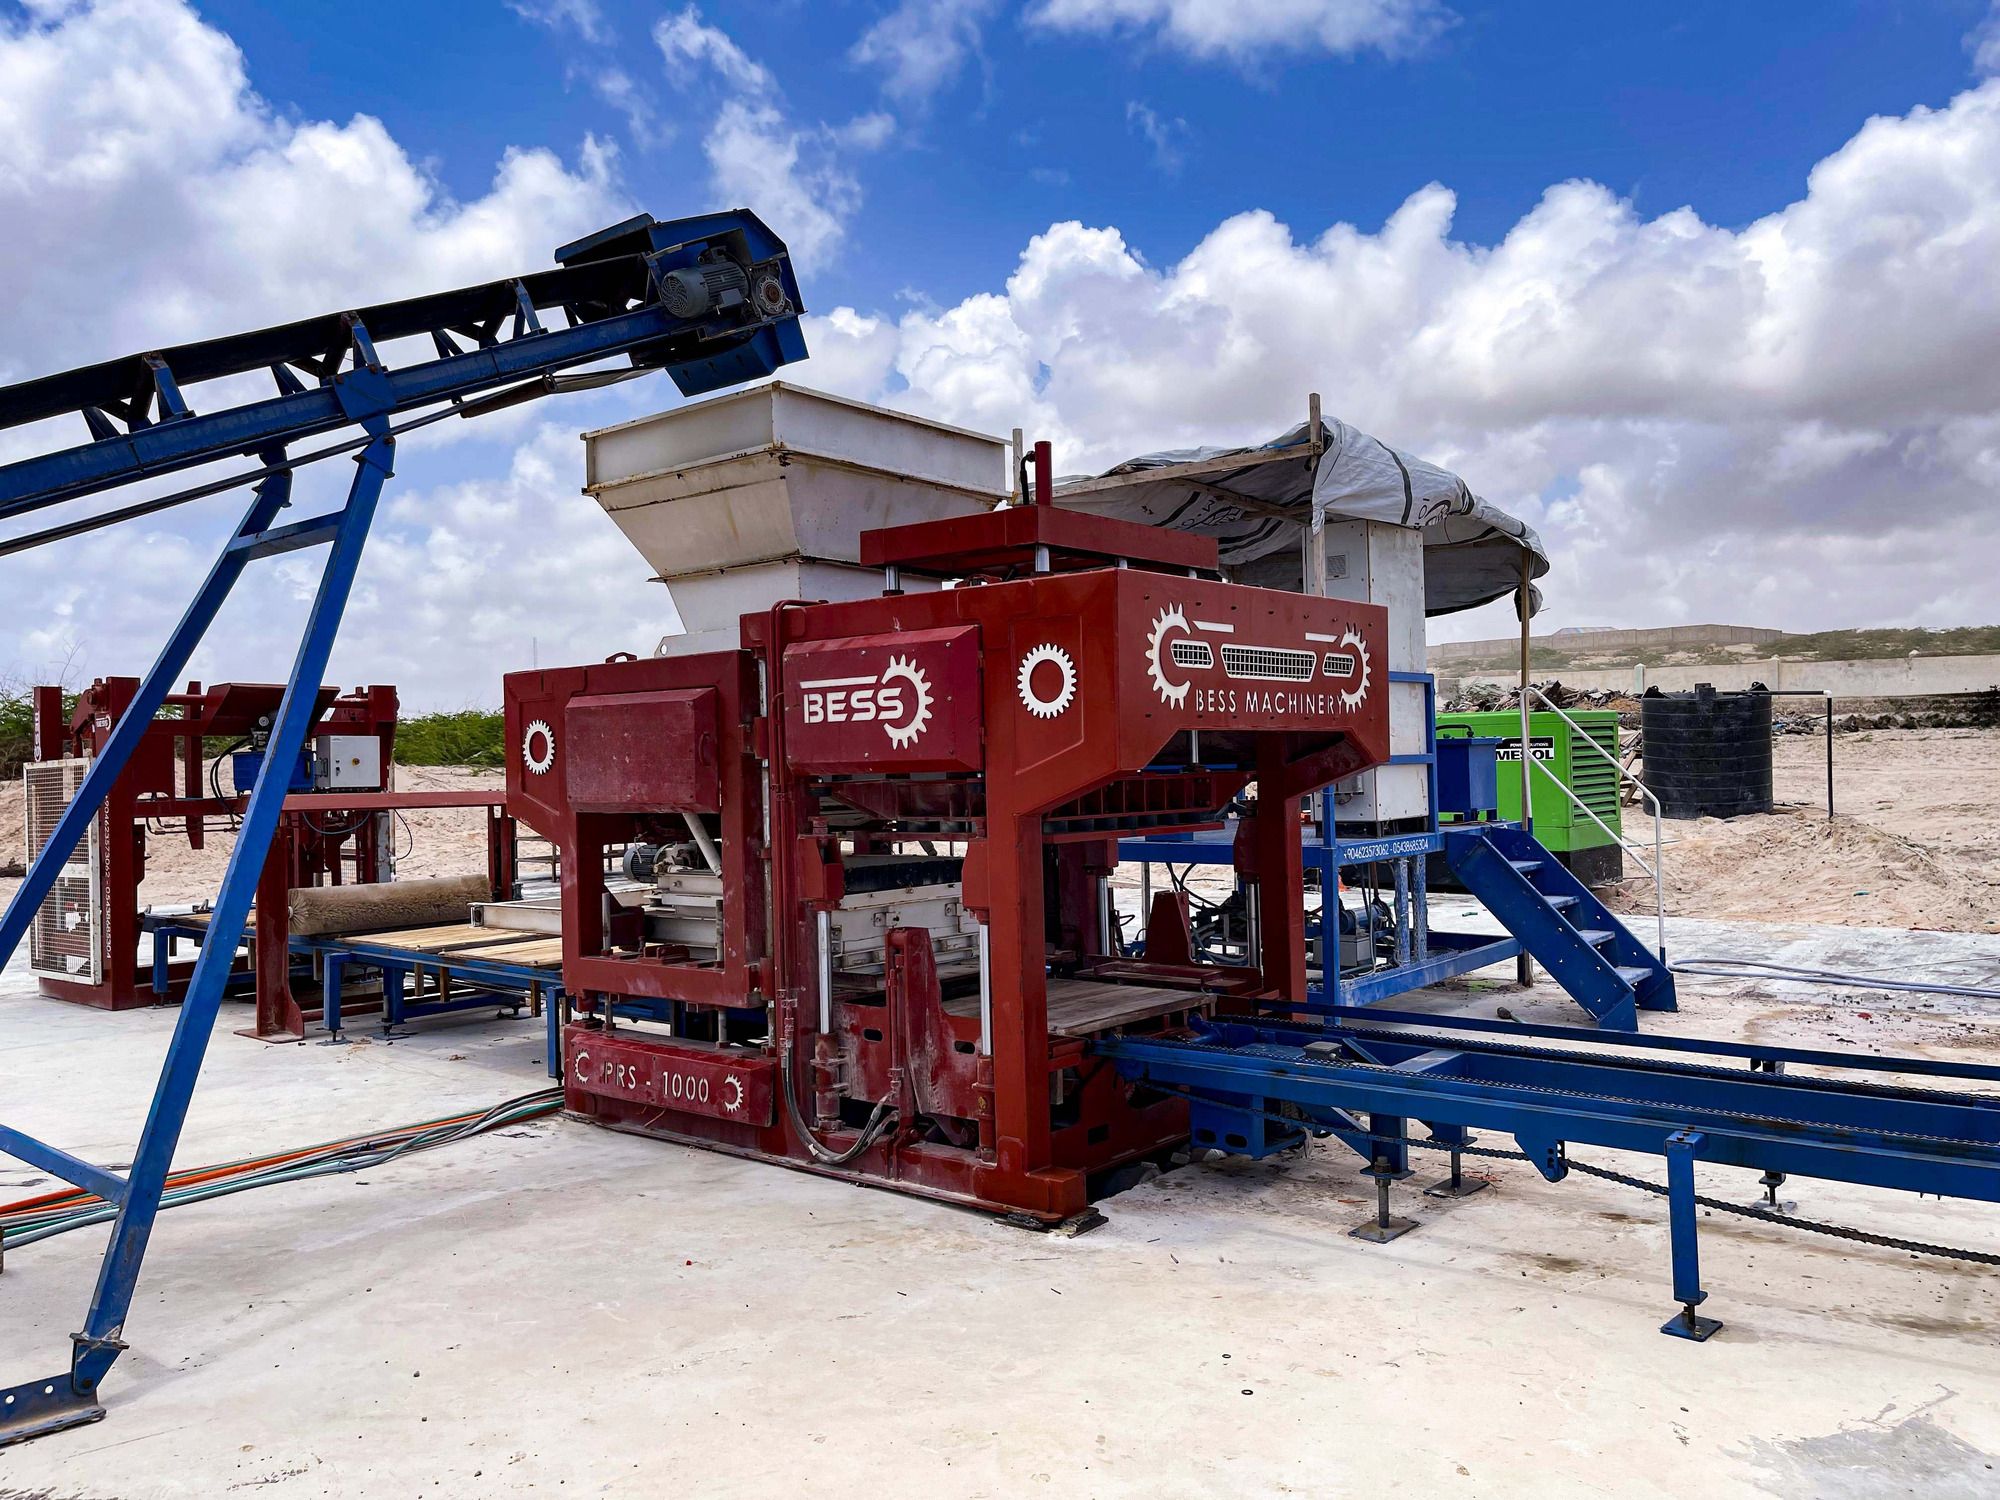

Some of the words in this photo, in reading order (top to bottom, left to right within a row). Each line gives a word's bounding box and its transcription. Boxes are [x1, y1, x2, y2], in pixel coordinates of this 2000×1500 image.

[804, 687, 904, 724] BESS
[1195, 689, 1237, 713] BESS
[1245, 691, 1344, 715] MACHINERY
[604, 1061, 636, 1090] PRS
[662, 1071, 709, 1103] 1000
